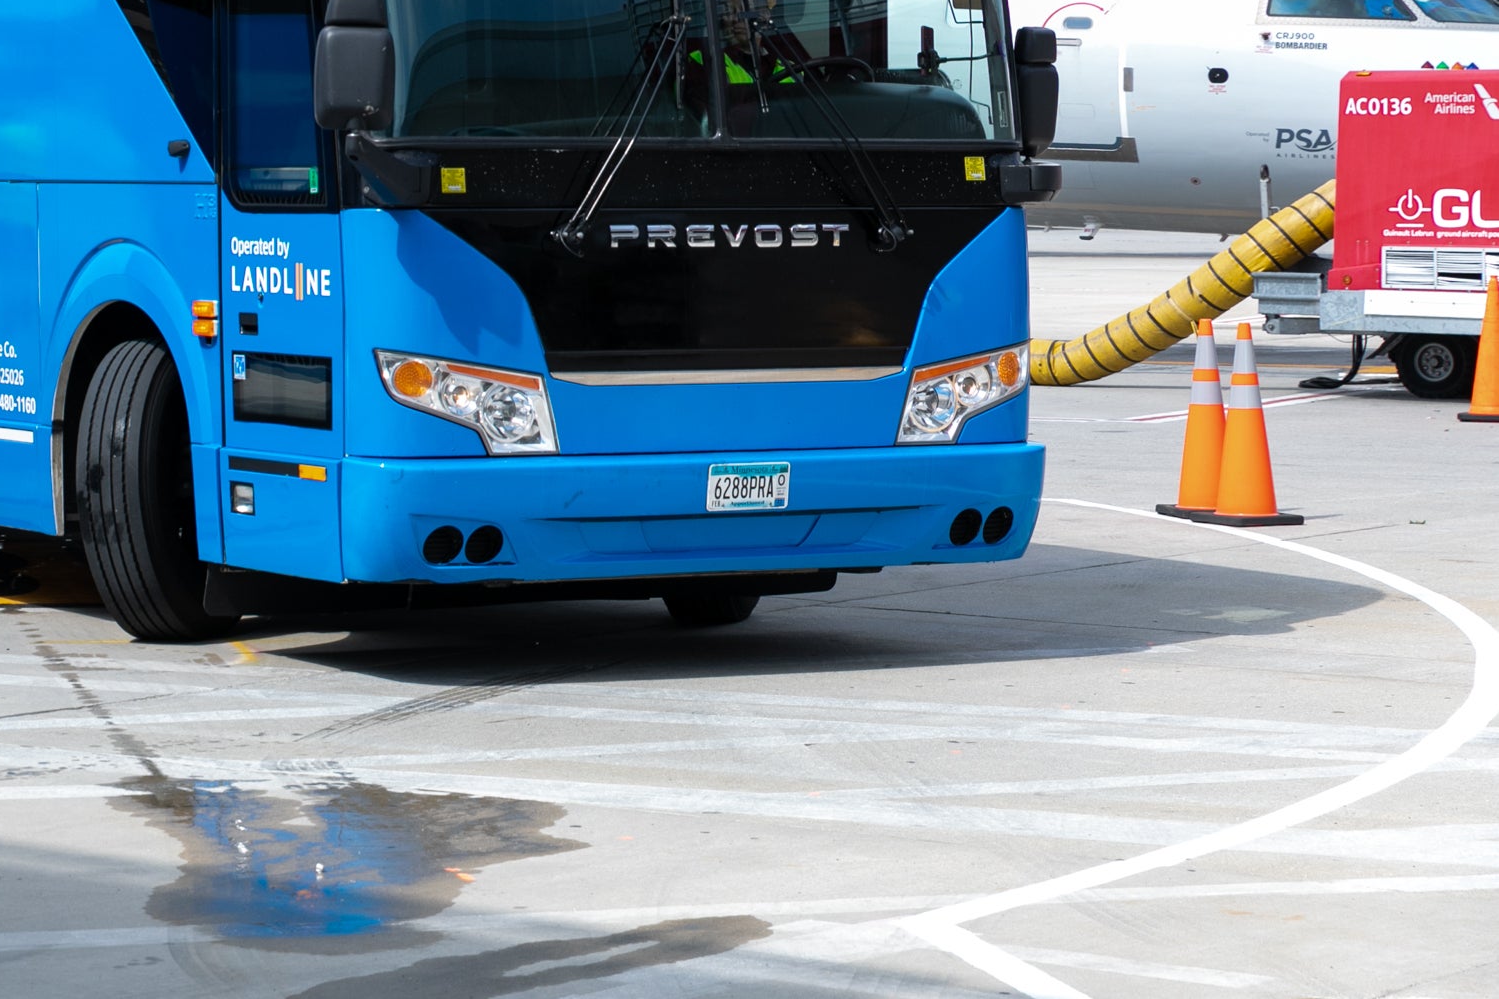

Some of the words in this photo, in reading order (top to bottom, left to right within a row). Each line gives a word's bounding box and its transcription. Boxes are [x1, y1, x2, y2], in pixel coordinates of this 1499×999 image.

[1275, 32, 1315, 40] CRJ900
[1275, 41, 1328, 50] BOMBARDIER
[1345, 97, 1412, 115] AC0136
[1424, 92, 1475, 103] American
[1434, 104, 1475, 114] Airlines
[1275, 128, 1332, 149] PSA
[609, 223, 850, 248] PREVOST
[1436, 230, 1461, 239] ground
[1461, 230, 1487, 238] aircraft
[231, 236, 275, 257] Operated
[277, 237, 290, 259] by
[4, 341, 17, 358] Co.
[714, 475, 774, 500] 6288PRA
